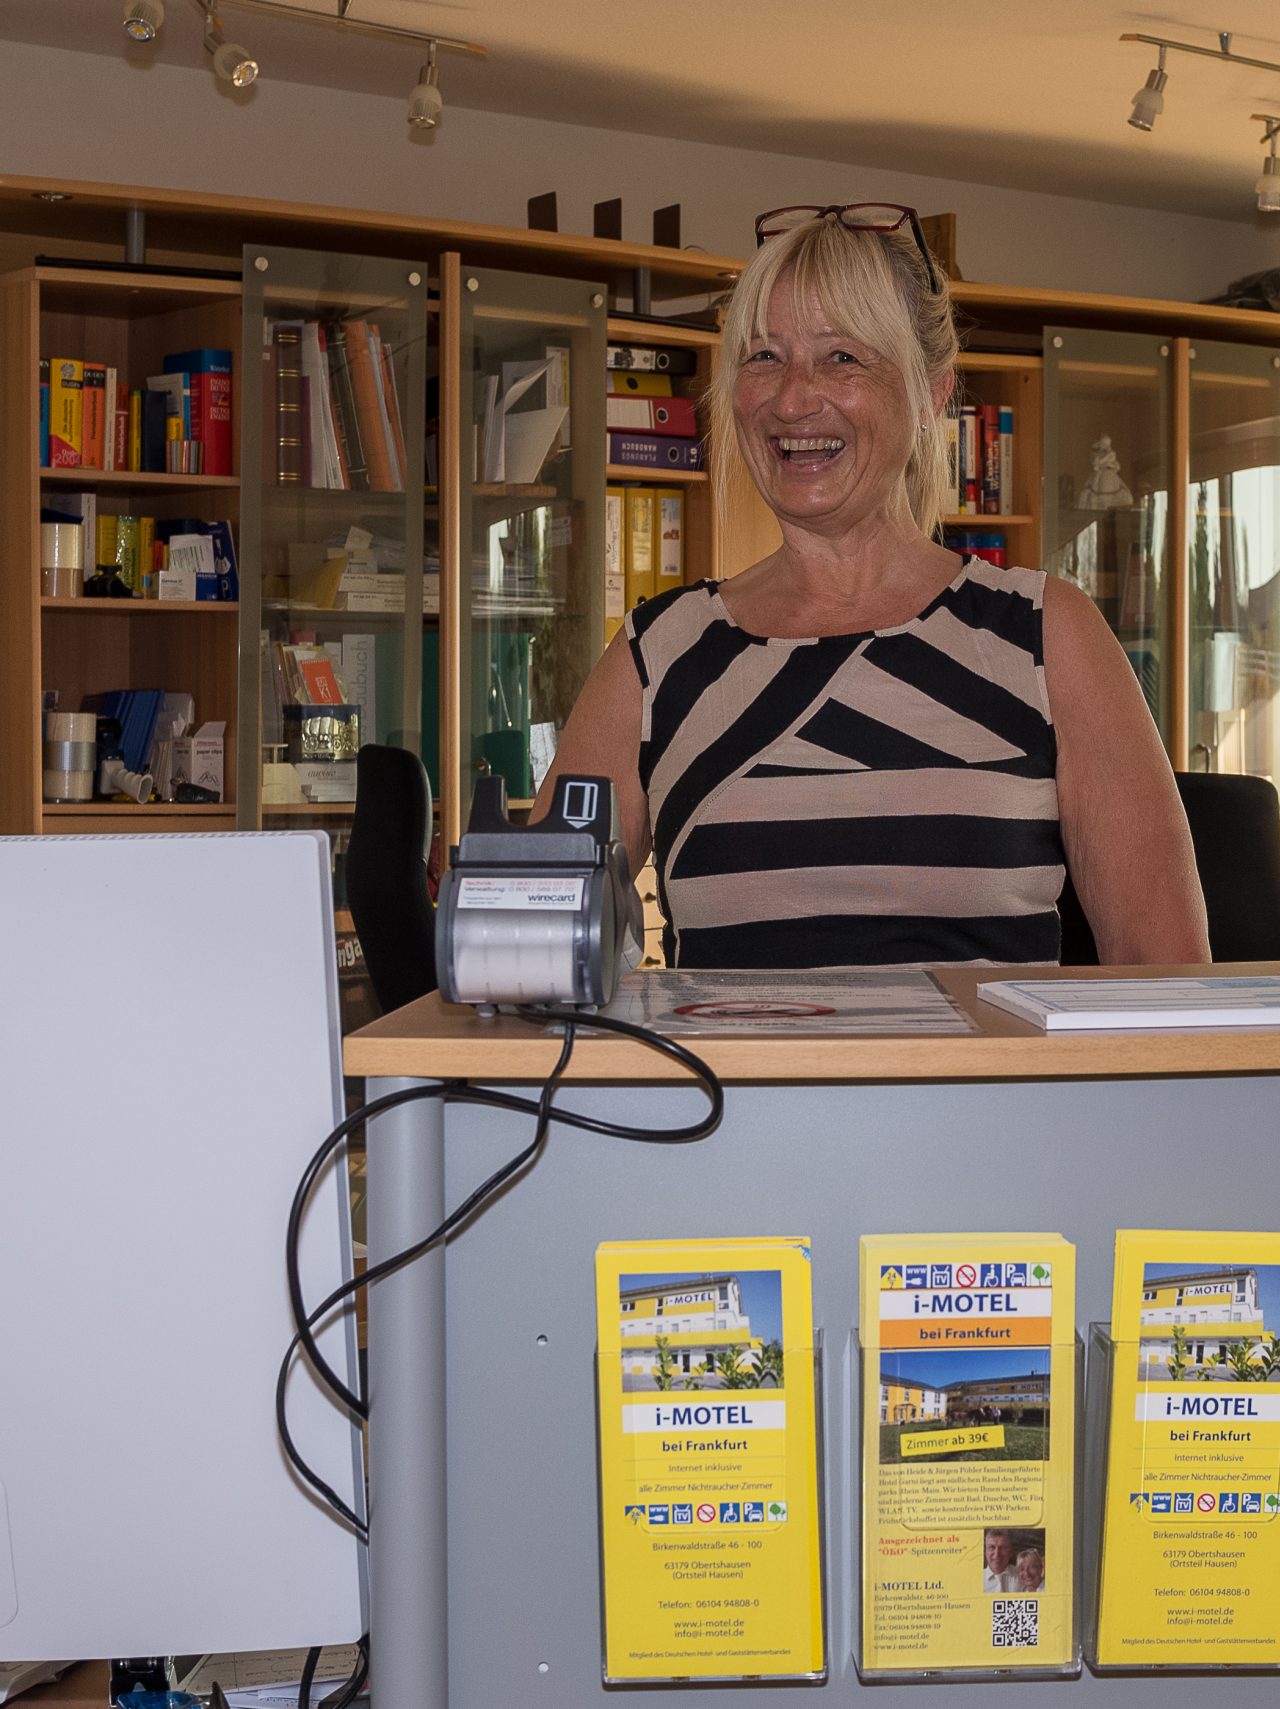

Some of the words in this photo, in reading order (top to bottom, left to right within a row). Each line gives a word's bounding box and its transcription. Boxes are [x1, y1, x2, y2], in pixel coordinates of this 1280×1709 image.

[528, 894, 576, 902] wirecard
[936, 1274, 946, 1284] TV
[1185, 1284, 1231, 1296] i-MOTEL
[665, 1292, 714, 1305] i-MOTEL
[913, 1293, 1018, 1313] i-MOTEL
[920, 1328, 941, 1340] bei
[945, 1328, 1011, 1339] Frankfurt
[1166, 1397, 1258, 1416] i-MOTEL
[655, 1405, 753, 1427] i-MOTEL
[906, 1438, 949, 1450] Zimmer
[951, 1435, 965, 1445] ab
[969, 1433, 989, 1444] 39€
[1170, 1431, 1189, 1442] bei
[1193, 1431, 1251, 1442] Frankfurt
[662, 1441, 682, 1452] bei
[686, 1440, 748, 1452] Frankfurt
[1174, 1454, 1207, 1462] Internet
[1209, 1454, 1244, 1462] inklusive
[668, 1463, 703, 1473] Internet
[705, 1462, 742, 1472] inklusive
[1144, 1473, 1157, 1481] alle
[1159, 1473, 1189, 1481] Zimmer
[1191, 1473, 1272, 1481] Nichtraucher-Zimmer
[639, 1484, 653, 1493] alle
[654, 1483, 686, 1492] Zimmer
[1178, 1501, 1189, 1509] TV
[677, 1512, 688, 1520] TV
[1153, 1531, 1223, 1539] Birkenwaldstraße
[1225, 1531, 1236, 1539] 46
[1243, 1531, 1258, 1539] 100
[879, 1536, 943, 1546] Ausgezeichnet
[947, 1535, 960, 1543] als
[653, 1541, 726, 1551] Birkenwaldstraße
[728, 1541, 739, 1549] 46
[747, 1541, 762, 1549] 100
[1163, 1550, 1186, 1559] 63179
[1188, 1550, 1245, 1559] Obertshausen
[664, 1561, 688, 1570] 63179
[691, 1561, 751, 1570] Obertshausen
[1170, 1560, 1202, 1568] (Ortsteil
[1204, 1560, 1237, 1568] Hausen)
[673, 1570, 707, 1580] (Ortsteil
[709, 1570, 744, 1580] Hausen)
[874, 1582, 922, 1591] i-MOTEL
[924, 1581, 944, 1590] Ltd.
[1154, 1588, 1186, 1597] Telefon:
[1189, 1589, 1214, 1597] 06104
[1216, 1589, 1250, 1597] 94808-0
[658, 1600, 692, 1610] Telefon:
[696, 1600, 721, 1608] 06104
[724, 1599, 759, 1608] 94808-0
[1167, 1607, 1234, 1616] www.i-motel.de
[674, 1619, 744, 1628] www.i-motel.de
[1167, 1617, 1233, 1626] info@i-motel.de
[674, 1629, 744, 1639] info@i-motel.de
